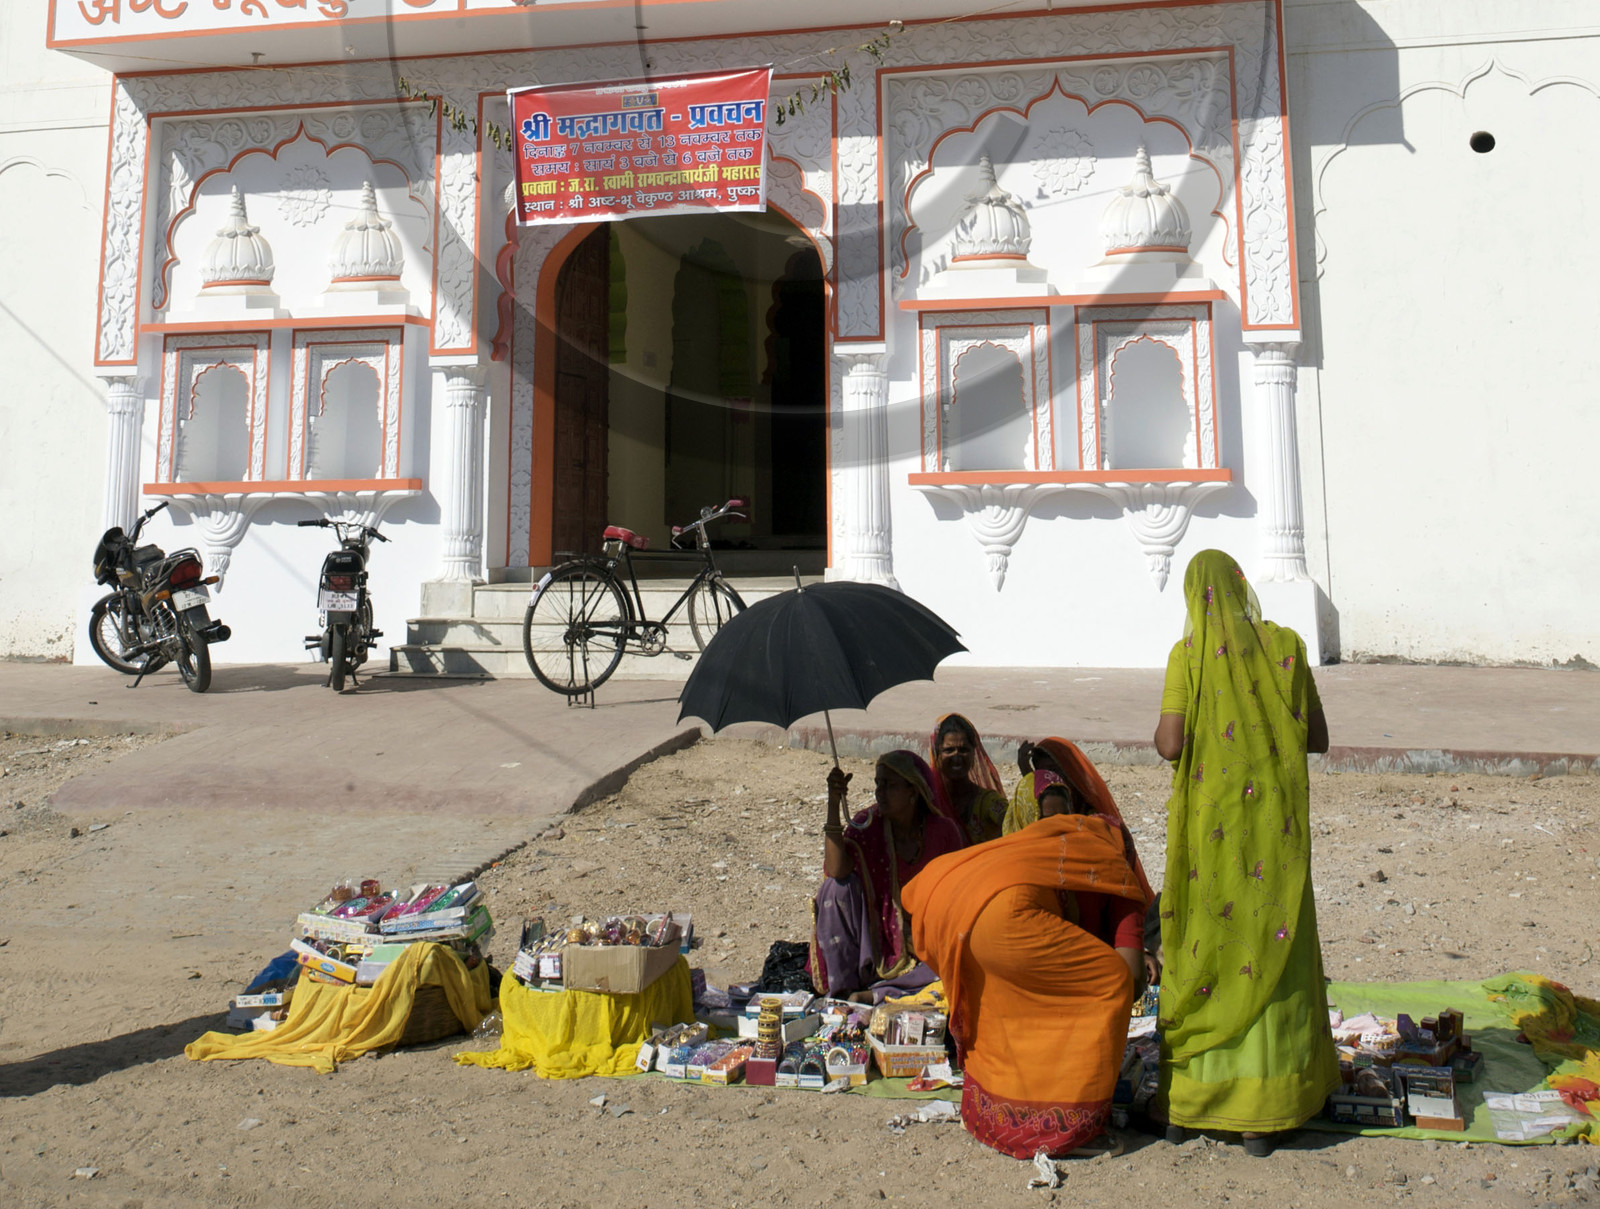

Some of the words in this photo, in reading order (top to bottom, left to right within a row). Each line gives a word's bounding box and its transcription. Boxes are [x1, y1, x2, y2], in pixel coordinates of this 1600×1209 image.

[520, 111, 553, 141] श्री
[556, 107, 665, 139] मद्भागवत
[687, 99, 765, 130] प्रवचन
[569, 143, 580, 155] 7
[583, 138, 634, 154] नवम्बर
[636, 133, 652, 150] से
[658, 135, 675, 148] 13
[679, 130, 731, 146] नवम्बर
[734, 128, 762, 142] तक
[531, 161, 570, 176] समय
[583, 154, 615, 172] सायं
[620, 156, 630, 169] 3
[633, 150, 659, 167] बजे
[662, 149, 678, 165] से
[682, 151, 692, 164] 6
[695, 145, 722, 162] बजे
[726, 147, 754, 160] तक
[522, 180, 557, 196] प्रवक्ता
[603, 170, 634, 190] स्वामी
[524, 200, 555, 212] स्थान
[568, 194, 583, 208] श्री
